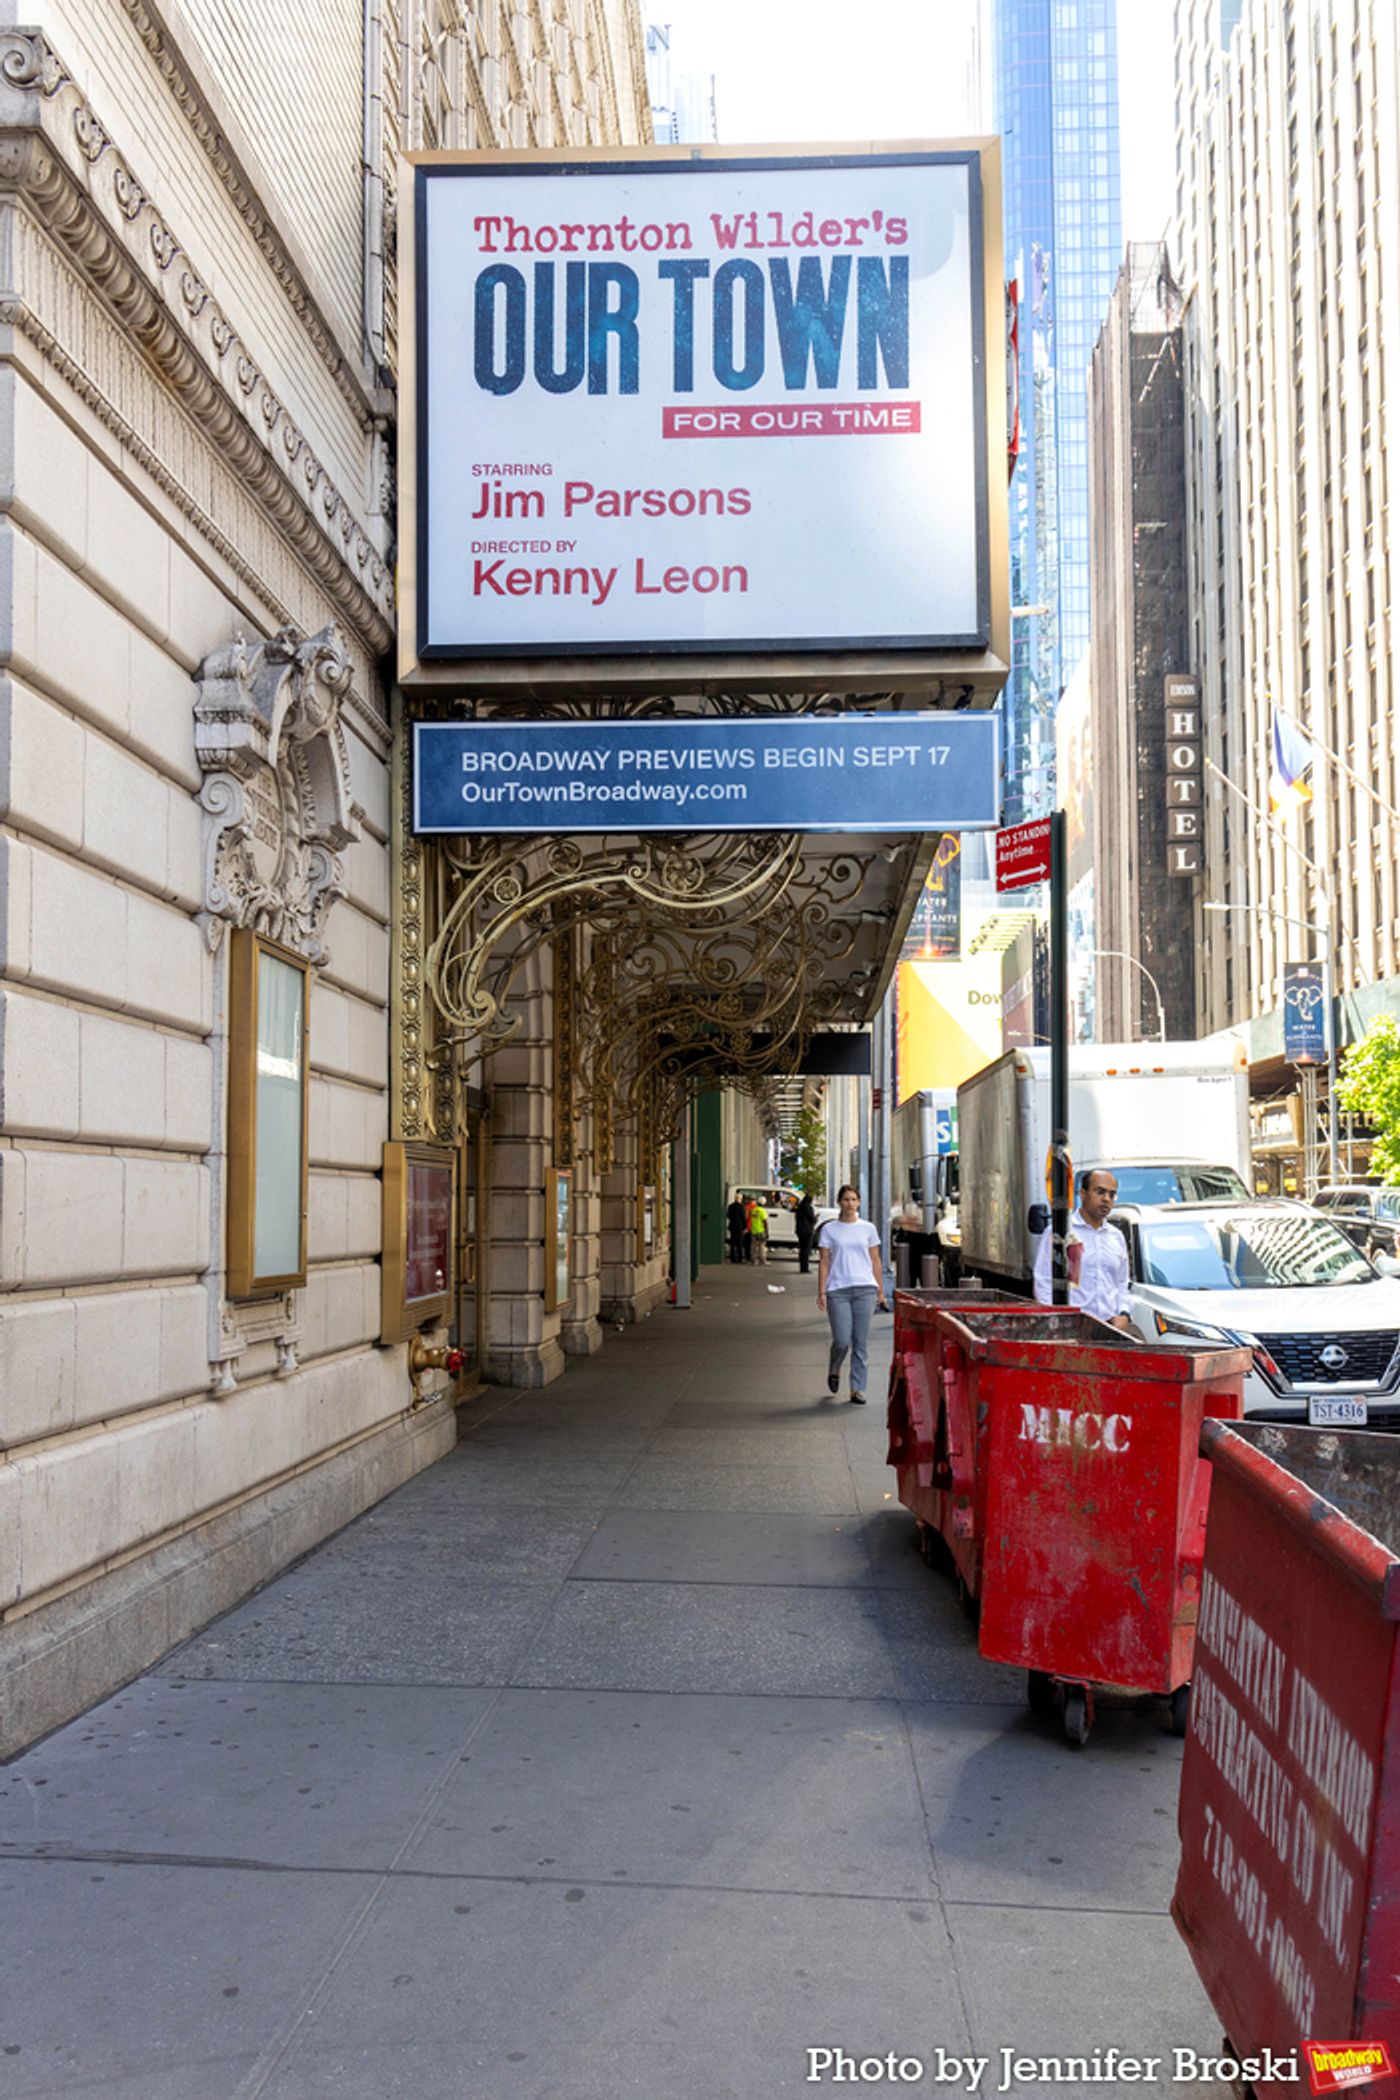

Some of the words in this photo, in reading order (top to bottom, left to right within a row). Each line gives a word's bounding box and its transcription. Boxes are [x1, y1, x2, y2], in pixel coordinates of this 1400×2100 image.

[474, 215, 693, 253] Thornton
[711, 210, 908, 250] Wilder's
[474, 261, 640, 395] OUR
[658, 255, 909, 393] TOWN
[673, 414, 739, 431] FOR
[756, 411, 824, 430] OUR
[839, 408, 911, 429] TIME
[471, 464, 553, 476] STARRING
[472, 481, 545, 519] Jim
[564, 481, 752, 518] Parsons
[471, 541, 551, 553] DIRECTED
[556, 541, 577, 553] BY
[474, 559, 619, 605] Kenny
[635, 558, 748, 594] Leon
[462, 751, 611, 772] BROADWAY
[618, 748, 755, 770] PREVIEWS
[763, 747, 845, 769] BEGIN
[853, 746, 922, 767] SEPT
[927, 746, 951, 766] 17
[461, 781, 747, 805] OurTownBroadway.com
[1171, 712, 1196, 870] HOTEL
[998, 834, 1011, 848] NO
[999, 845, 1034, 863] Anytime
[1018, 1403, 1133, 1453] MICC
[1198, 1568, 1286, 1736] MANHATTAN
[1288, 1667, 1374, 1858] INTERIOR
[1191, 1665, 1292, 1862] CONTRACTING
